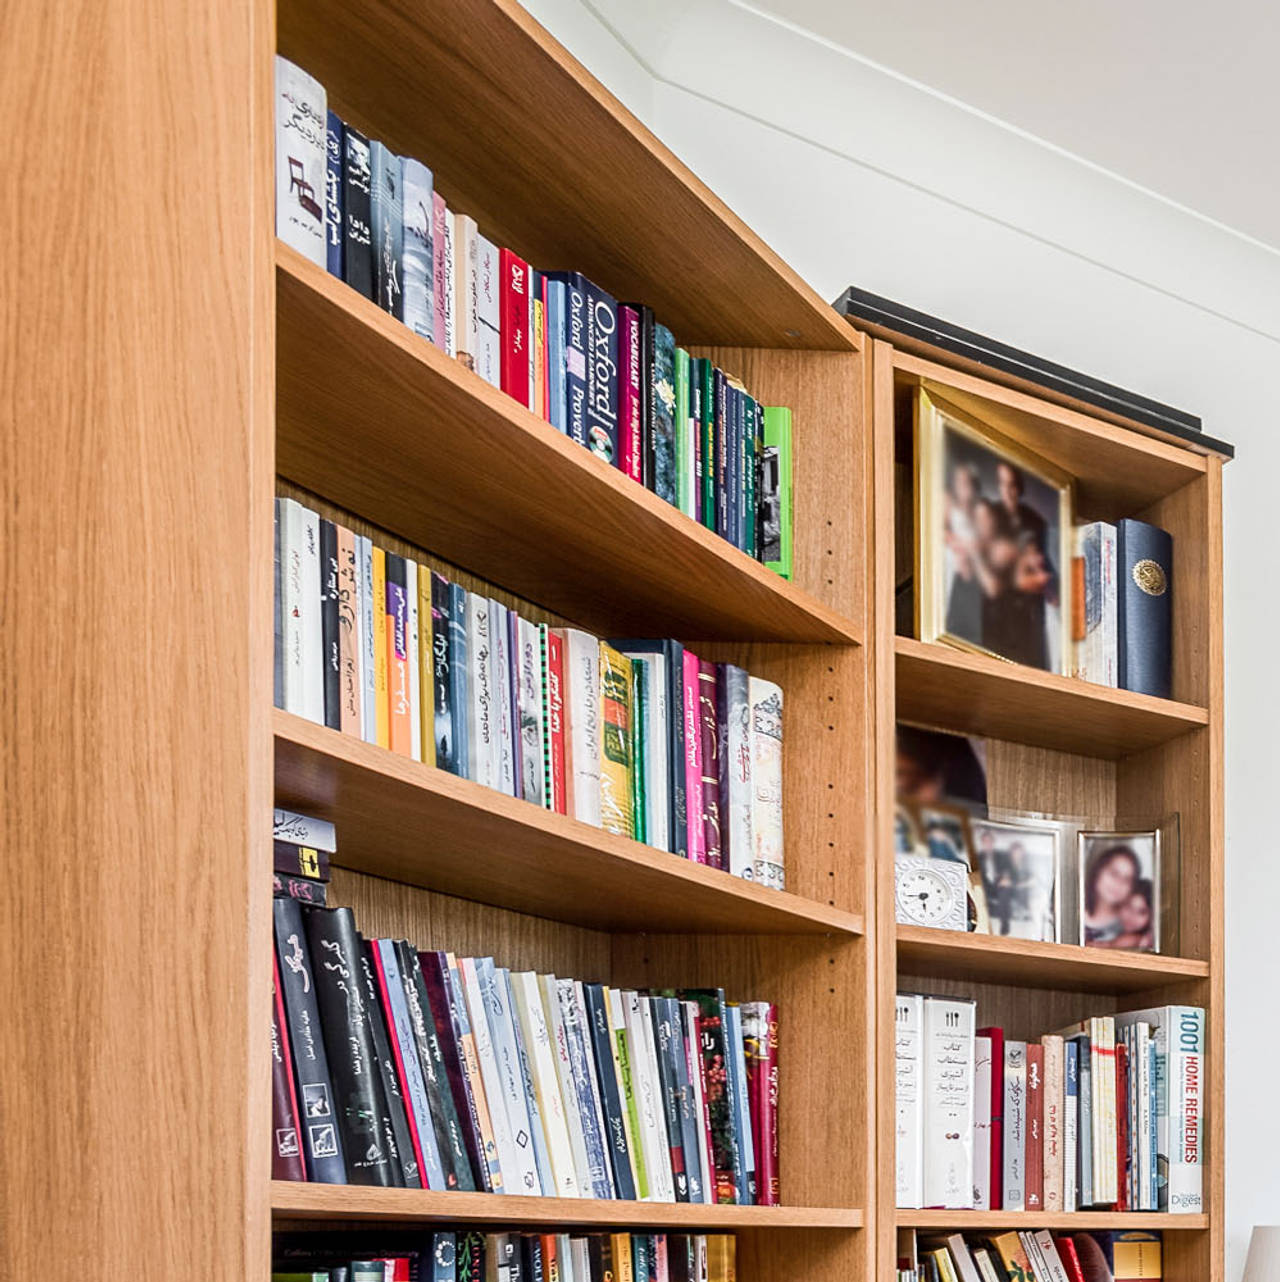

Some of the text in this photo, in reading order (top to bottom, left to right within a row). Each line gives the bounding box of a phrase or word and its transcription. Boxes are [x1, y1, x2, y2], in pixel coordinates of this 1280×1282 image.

[571, 291, 584, 350] Oxford
[630, 320, 639, 389] VOCABULARY
[595, 301, 616, 420] Oxford
[1180, 1012, 1199, 1053] 1001
[1185, 1056, 1198, 1163] HOME REMEDIES
